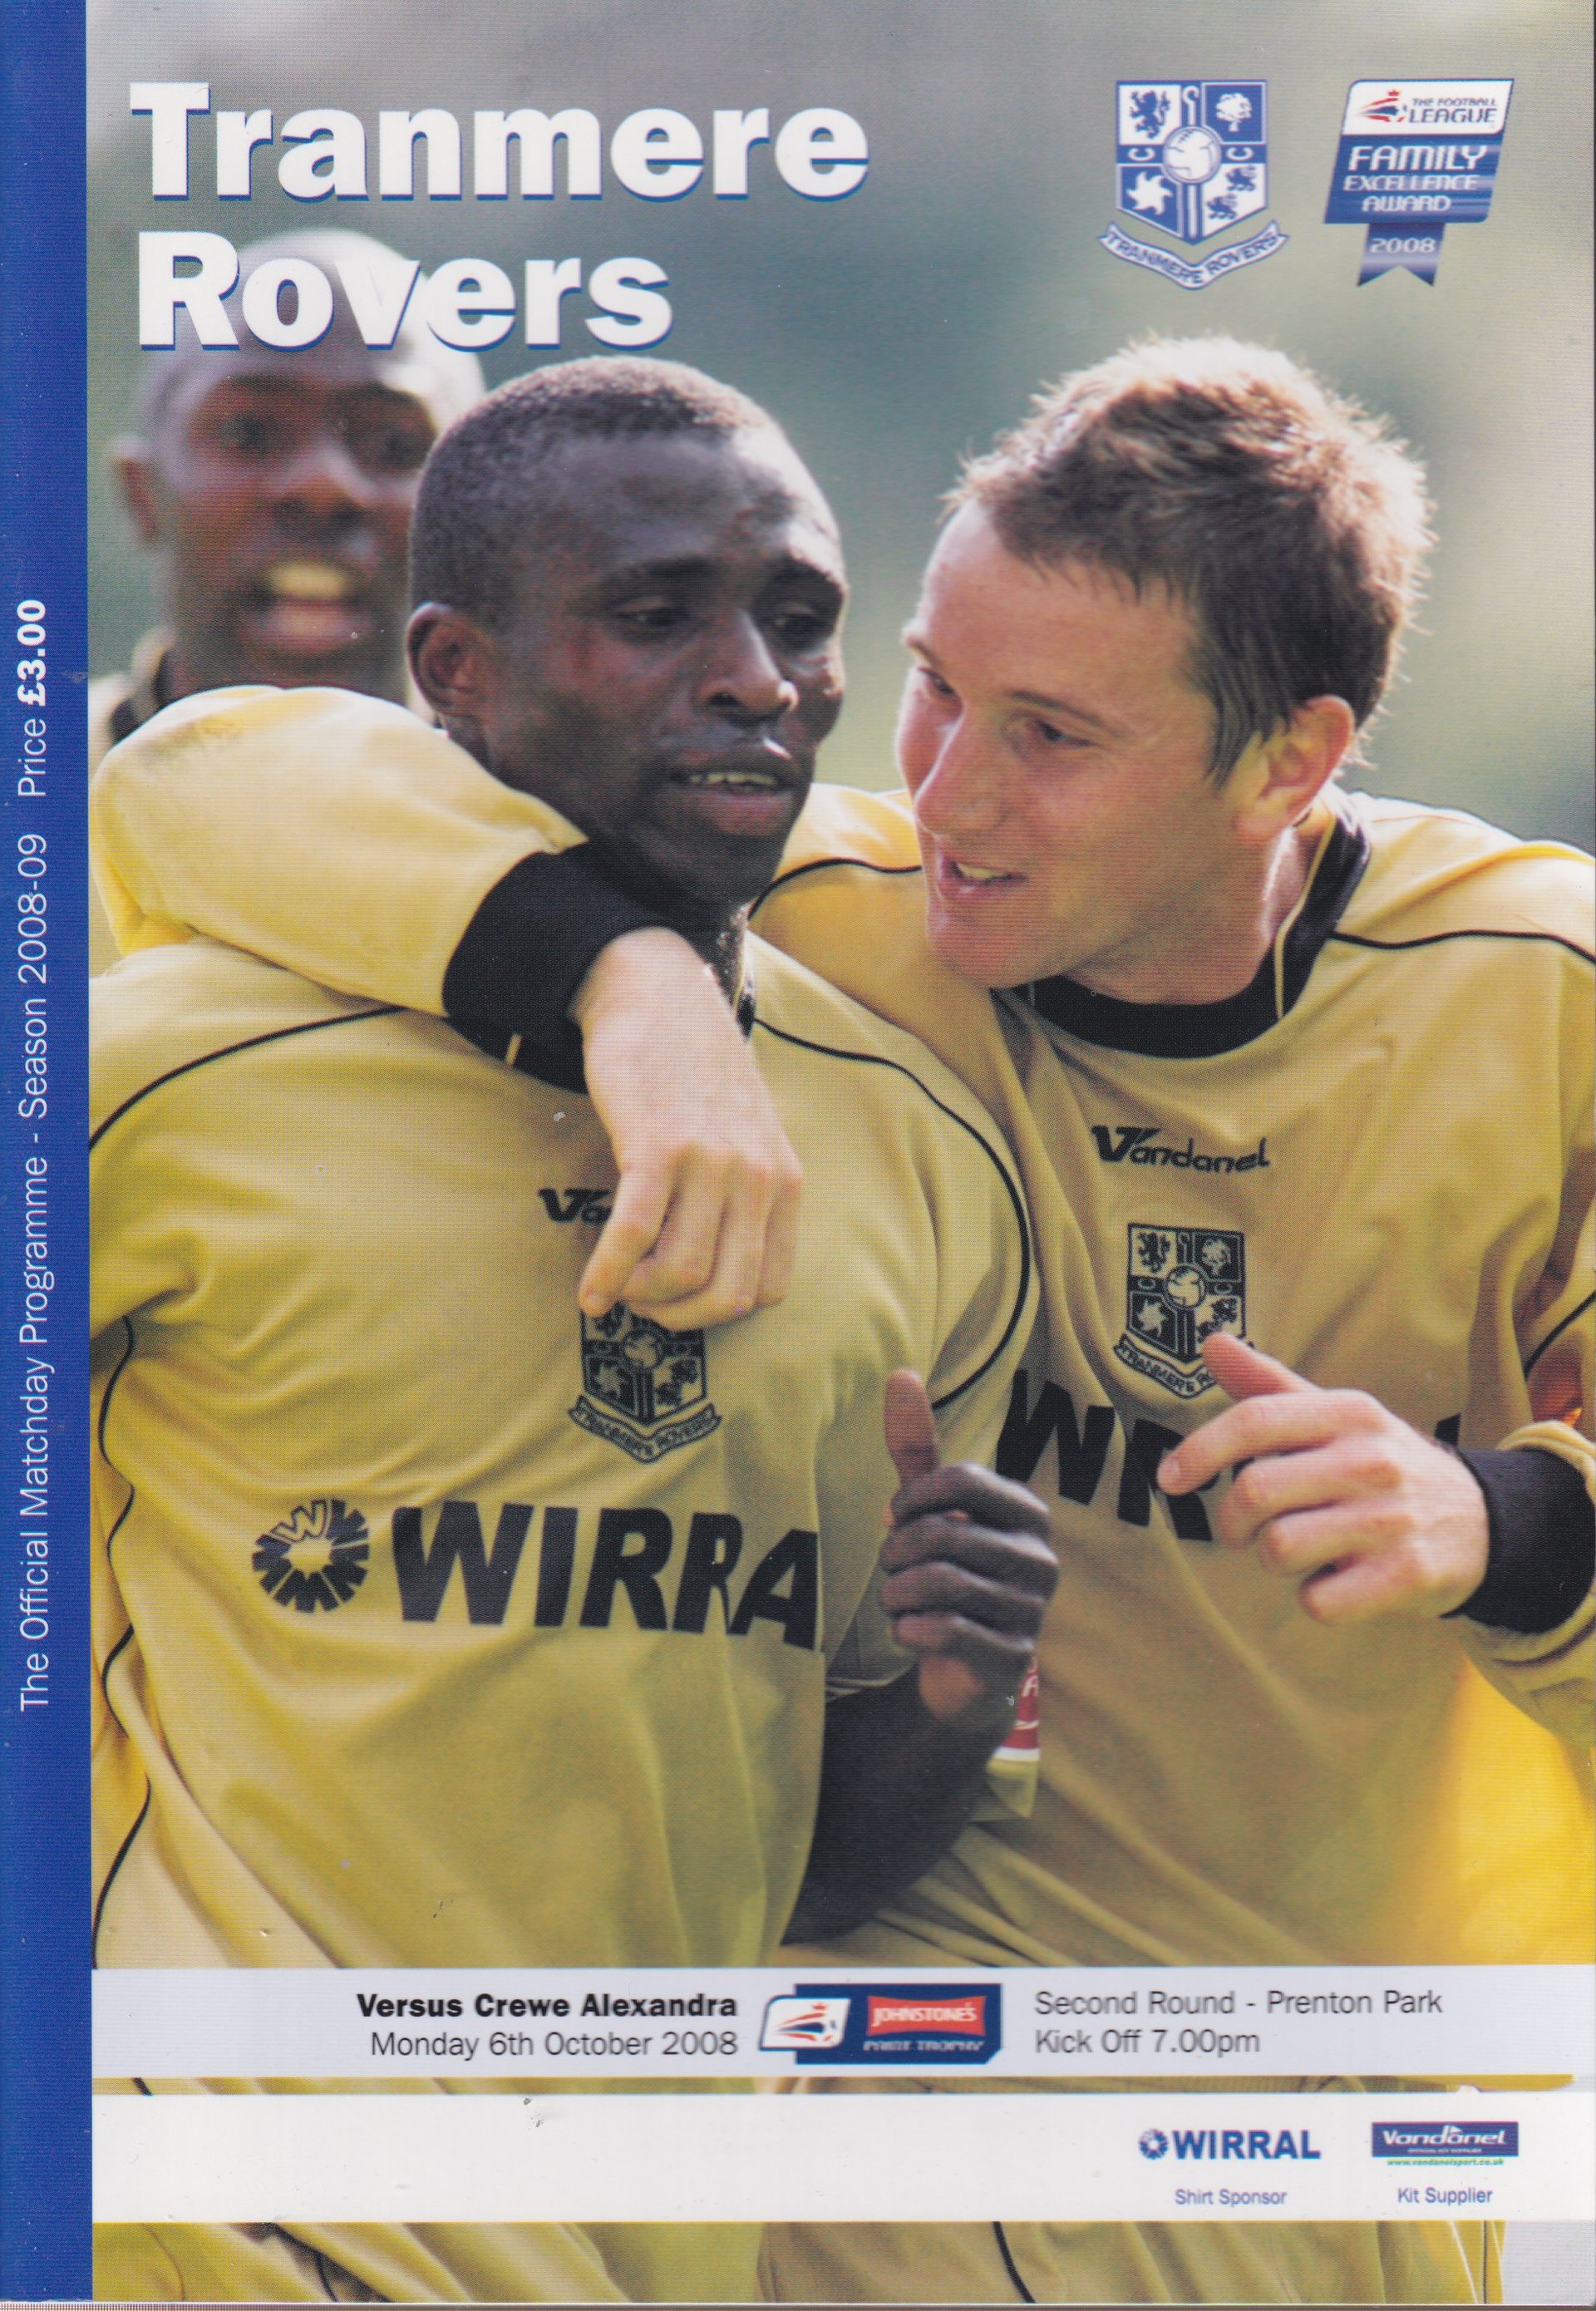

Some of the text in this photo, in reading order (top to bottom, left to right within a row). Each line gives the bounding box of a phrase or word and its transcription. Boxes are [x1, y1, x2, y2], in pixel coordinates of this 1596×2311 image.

[1409, 108, 1497, 123] LEAGUE
[1412, 98, 1497, 106] THE FOOTBALL
[129, 82, 869, 202] Tranmere
[1347, 145, 1488, 171] FAMILY
[1343, 175, 1480, 191] EXCELLENCE
[1361, 195, 1451, 212] AWARD
[1106, 230, 1278, 284] TRANMERE ROVERS
[1370, 238, 1436, 254] 2008
[138, 230, 673, 352] Rovers
[17, 599, 47, 707] £3.00
[17, 718, 47, 796] Price
[17, 834, 47, 984] 2008-09
[17, 998, 47, 1119] Season
[1091, 1126, 1270, 1172] Vandanel
[19, 1157, 54, 1344] Programme
[19, 1357, 54, 1515] Matchday
[19, 1532, 48, 1639] Official
[20, 1653, 48, 1712] The
[357, 1993, 737, 2017] Versus Crewe Alexandra
[1034, 1992, 1138, 2015] Second
[1148, 1992, 1235, 2015] Round
[1267, 1990, 1372, 2013] Prenton
[1383, 1990, 1444, 2013] Park
[371, 2032, 738, 2061] Monday 6th October 2008
[1035, 2028, 1261, 2058] Kick Off 7.00pm
[1172, 2130, 1322, 2160] WIRRAL
[1382, 2125, 1507, 2146] Vandanel
[1175, 2189, 1288, 2207] Shirt Sponsor
[1397, 2187, 1494, 2205] Kit Supplier
